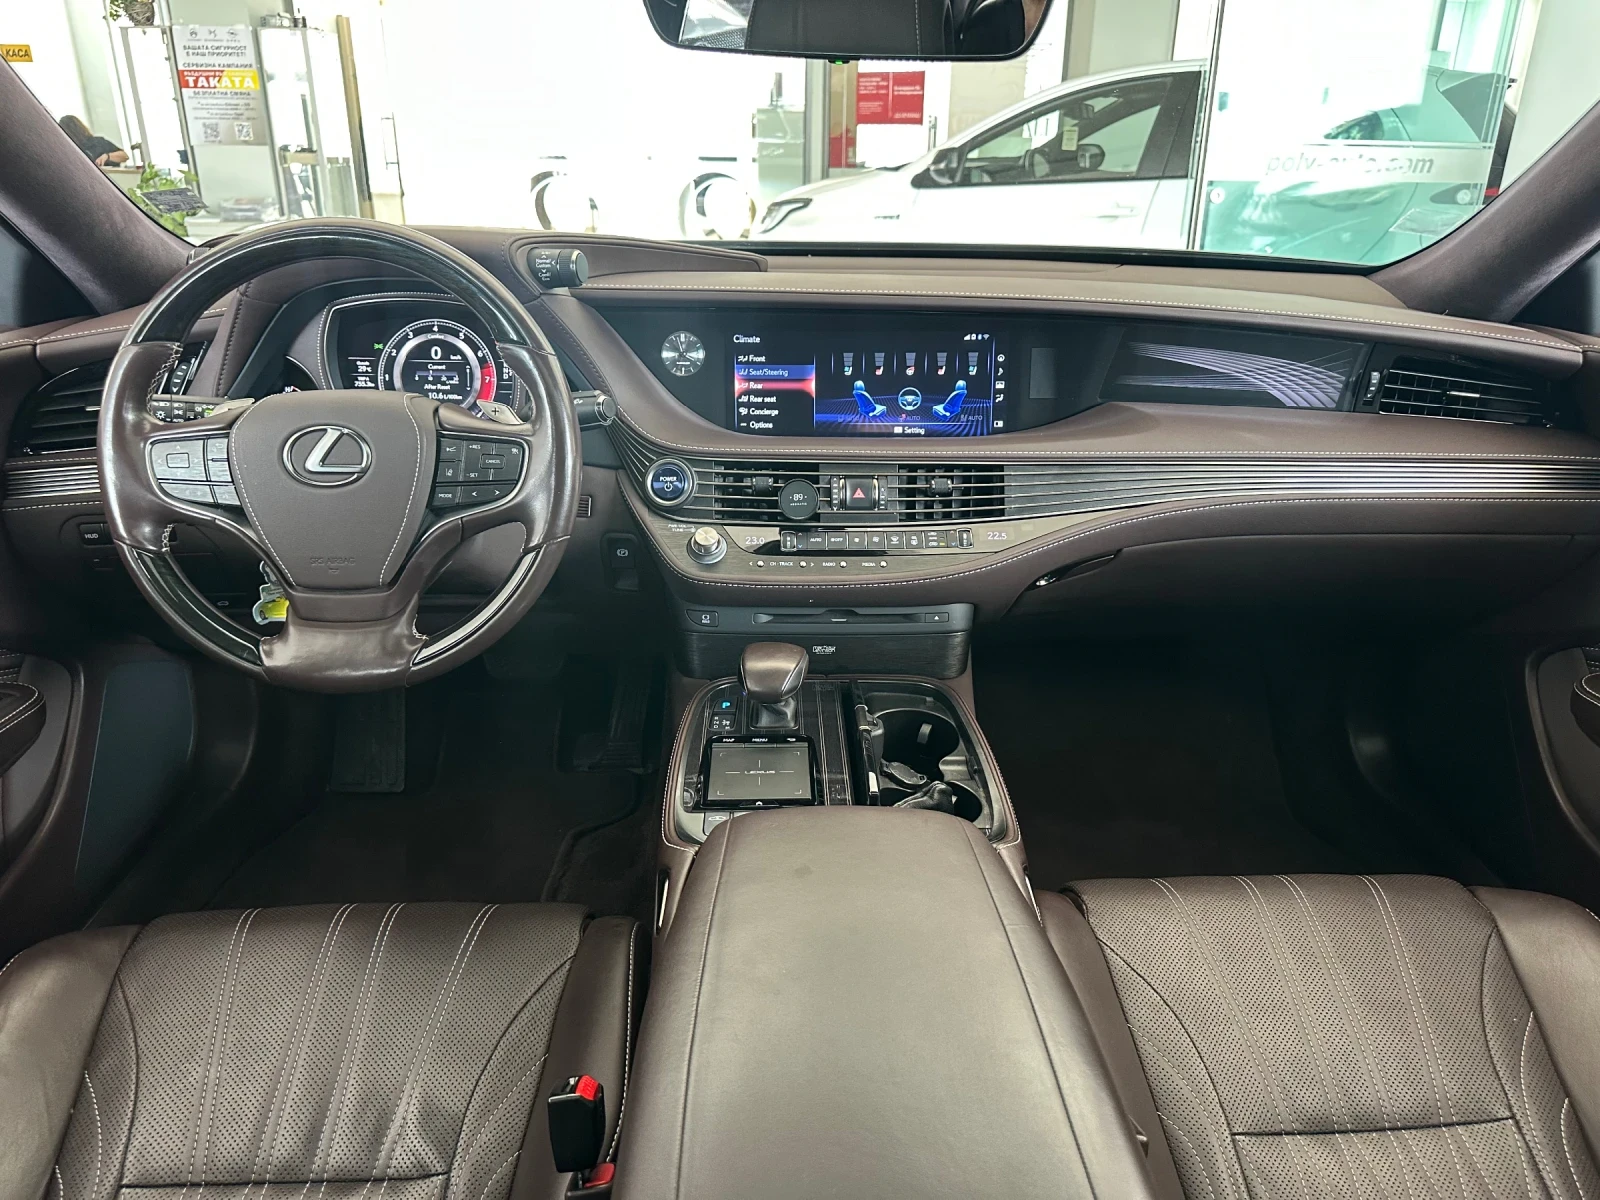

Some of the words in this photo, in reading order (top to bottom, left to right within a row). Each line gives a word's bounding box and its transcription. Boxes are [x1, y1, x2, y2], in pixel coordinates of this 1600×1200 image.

[5, 48, 30, 58] КАСА
[407, 331, 414, 339] 3
[733, 334, 761, 343] Climate
[431, 345, 442, 360] 0
[749, 354, 766, 362] Front
[749, 368, 788, 377] Seat/Steering
[749, 381, 763, 389] Rear
[749, 421, 774, 429] Options
[904, 426, 925, 434] Setting
[793, 493, 804, 501] 89
[987, 531, 1008, 540] 22.5
[745, 536, 765, 545] 23.0
[722, 701, 731, 709] P
